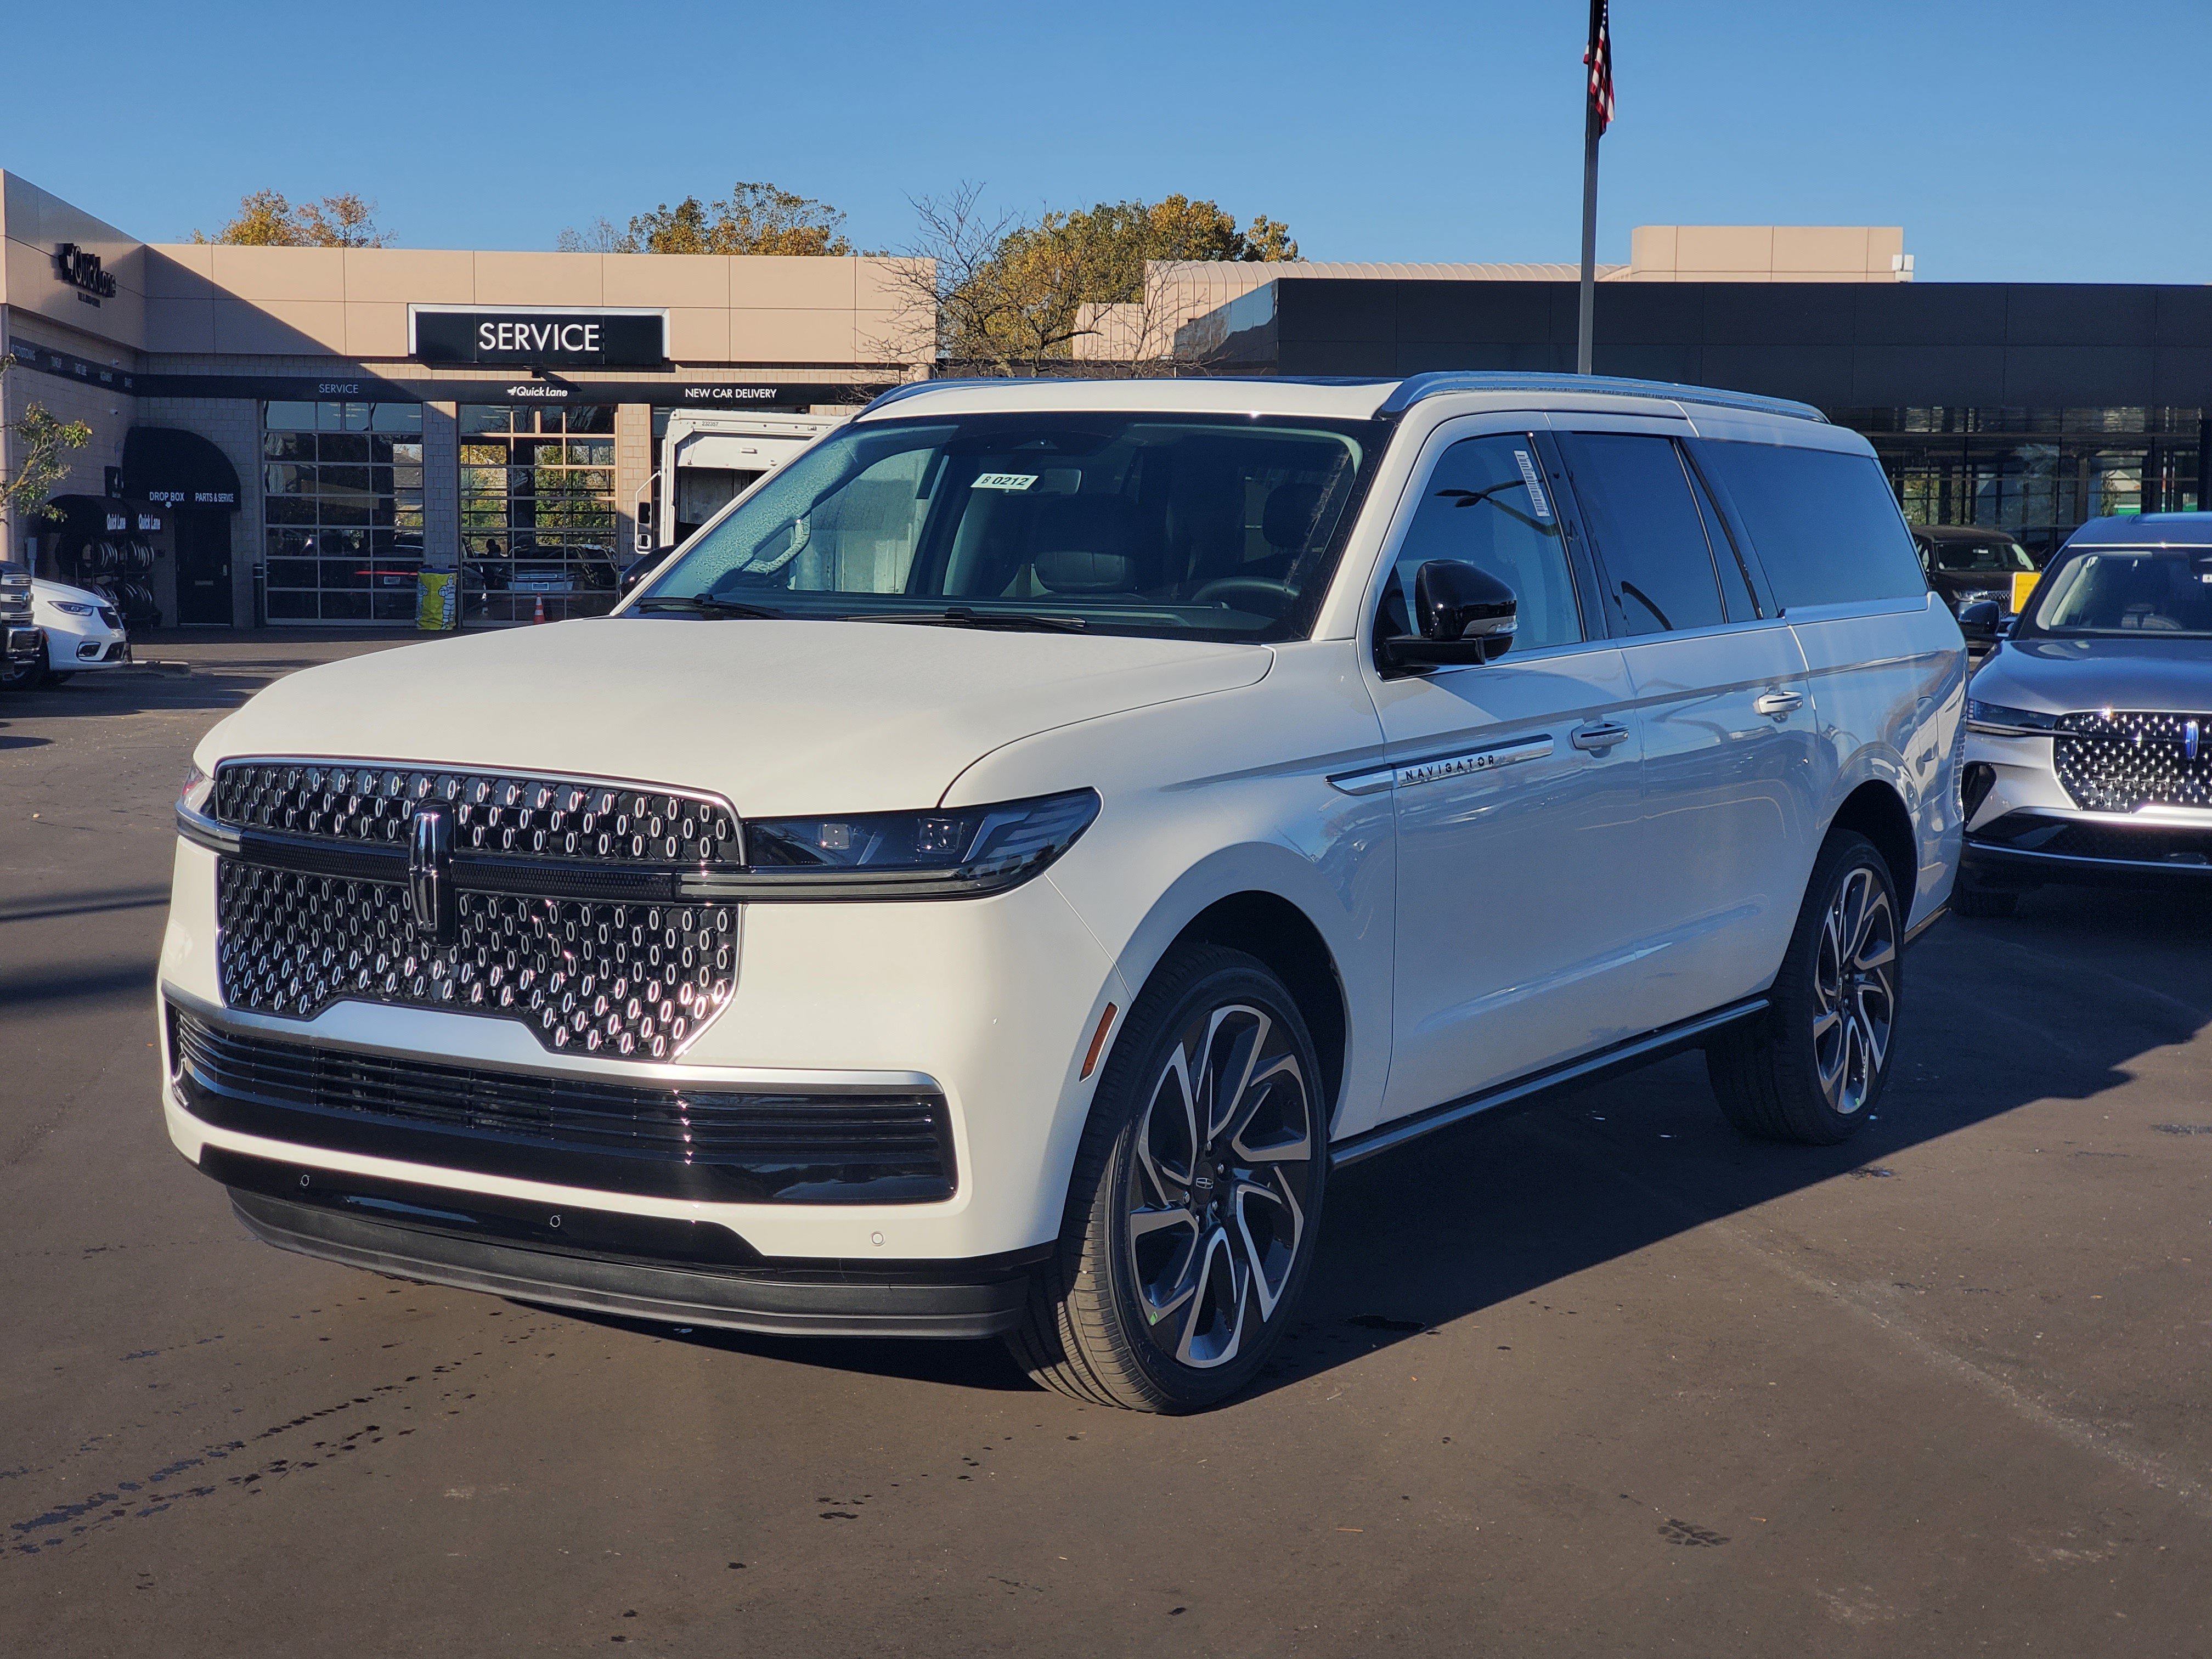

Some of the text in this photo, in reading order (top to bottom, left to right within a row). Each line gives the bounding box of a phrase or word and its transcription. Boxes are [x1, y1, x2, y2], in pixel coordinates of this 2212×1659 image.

[479, 323, 600, 351] SERVICE
[319, 384, 359, 393] SERVICE
[516, 386, 568, 397] Quick Lane
[685, 388, 777, 398] NEW CAR DELIVERY
[991, 476, 1030, 486] 0212
[149, 492, 185, 501] DROP BOX
[195, 493, 234, 503] PARTS & SERVICE
[138, 513, 150, 530] Quick
[1406, 755, 1494, 781] NAVIGATOR
